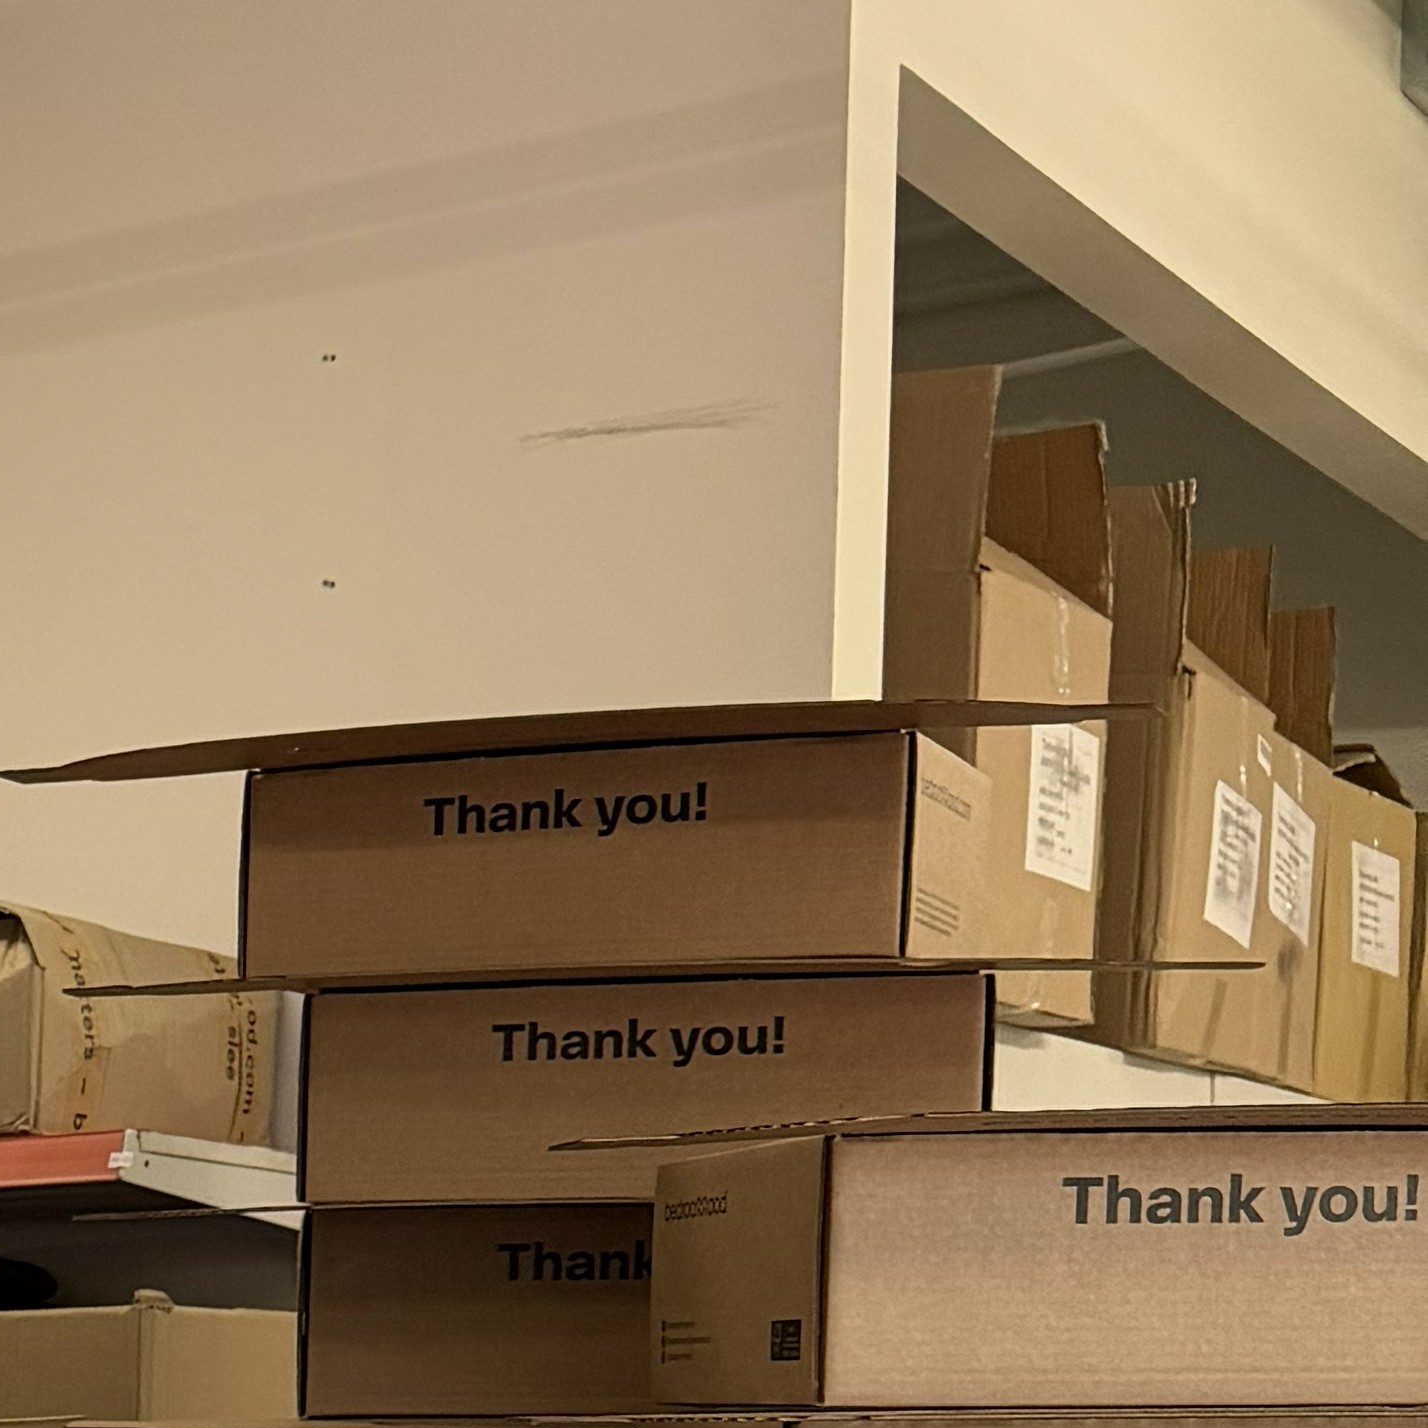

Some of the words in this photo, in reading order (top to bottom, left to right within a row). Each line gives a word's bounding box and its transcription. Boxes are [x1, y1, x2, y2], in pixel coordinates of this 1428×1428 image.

[423, 788, 581, 837] Thank
[594, 782, 708, 837] you!
[492, 1017, 657, 1062] Thank
[670, 1016, 785, 1067] you!
[1062, 1173, 1266, 1225] Thank
[1280, 1173, 1420, 1237] you!
